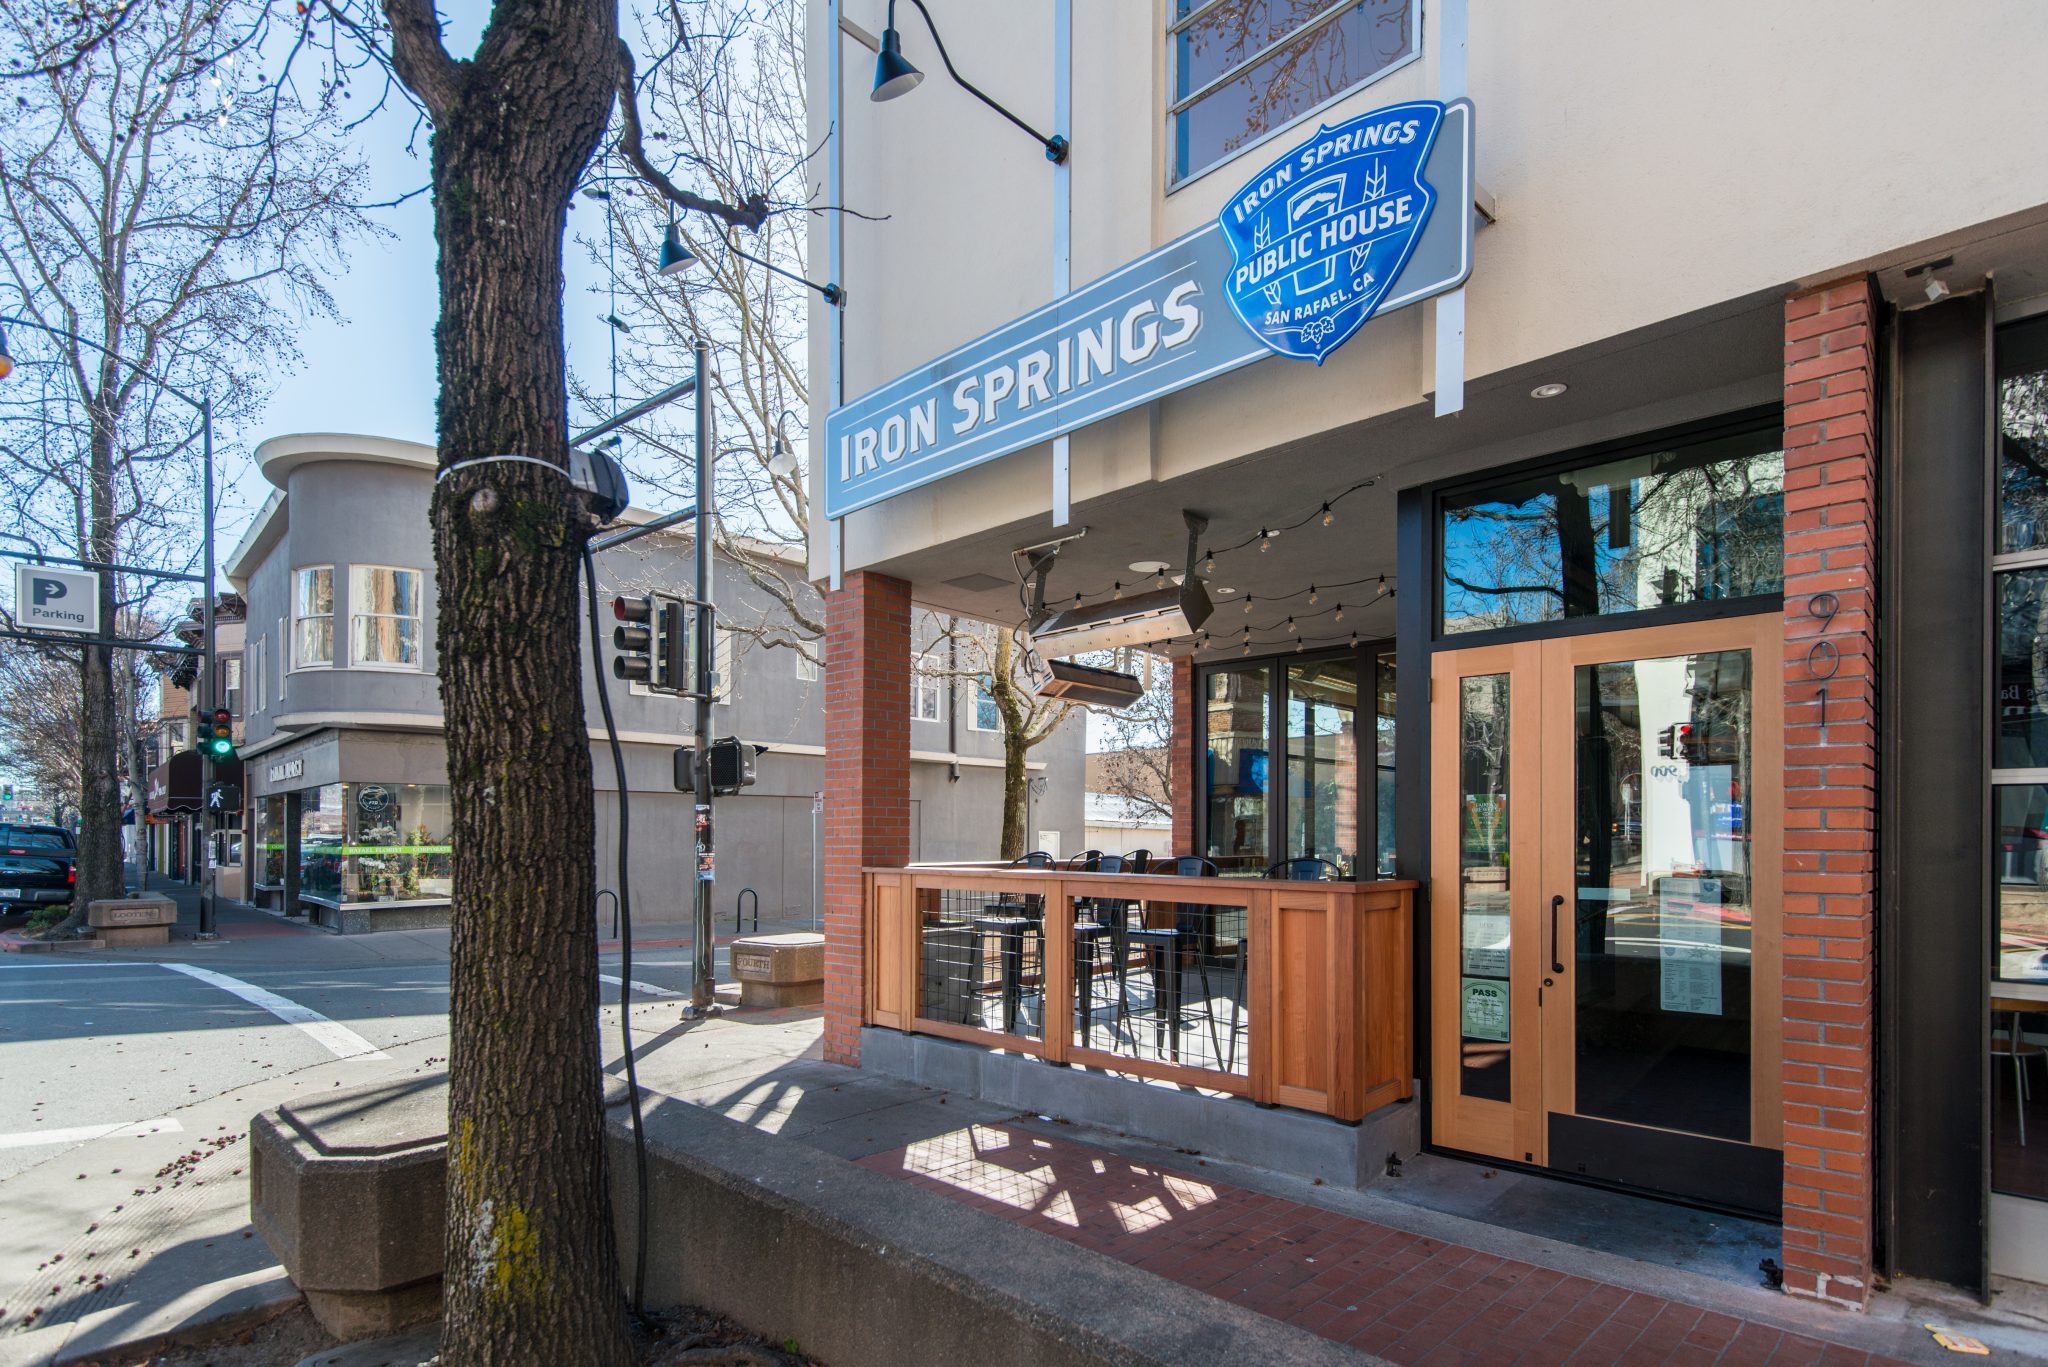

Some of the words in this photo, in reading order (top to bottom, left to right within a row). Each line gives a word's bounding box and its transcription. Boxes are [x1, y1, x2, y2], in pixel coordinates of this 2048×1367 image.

[1234, 163, 1293, 224] IRON
[1300, 119, 1420, 173] SPRINGS
[1236, 230, 1313, 293] PUBLIC
[1320, 194, 1413, 250] HOUSE
[1265, 309, 1290, 325] SAN
[1294, 290, 1352, 321] RAFAEL,
[1353, 272, 1375, 291] CA
[841, 397, 938, 483] IRON
[952, 279, 1204, 436] SPRINGS
[33, 608, 84, 623] Parking
[1808, 593, 1840, 727] 901
[737, 957, 770, 969] FOURTH
[1472, 988, 1498, 997] PASS
